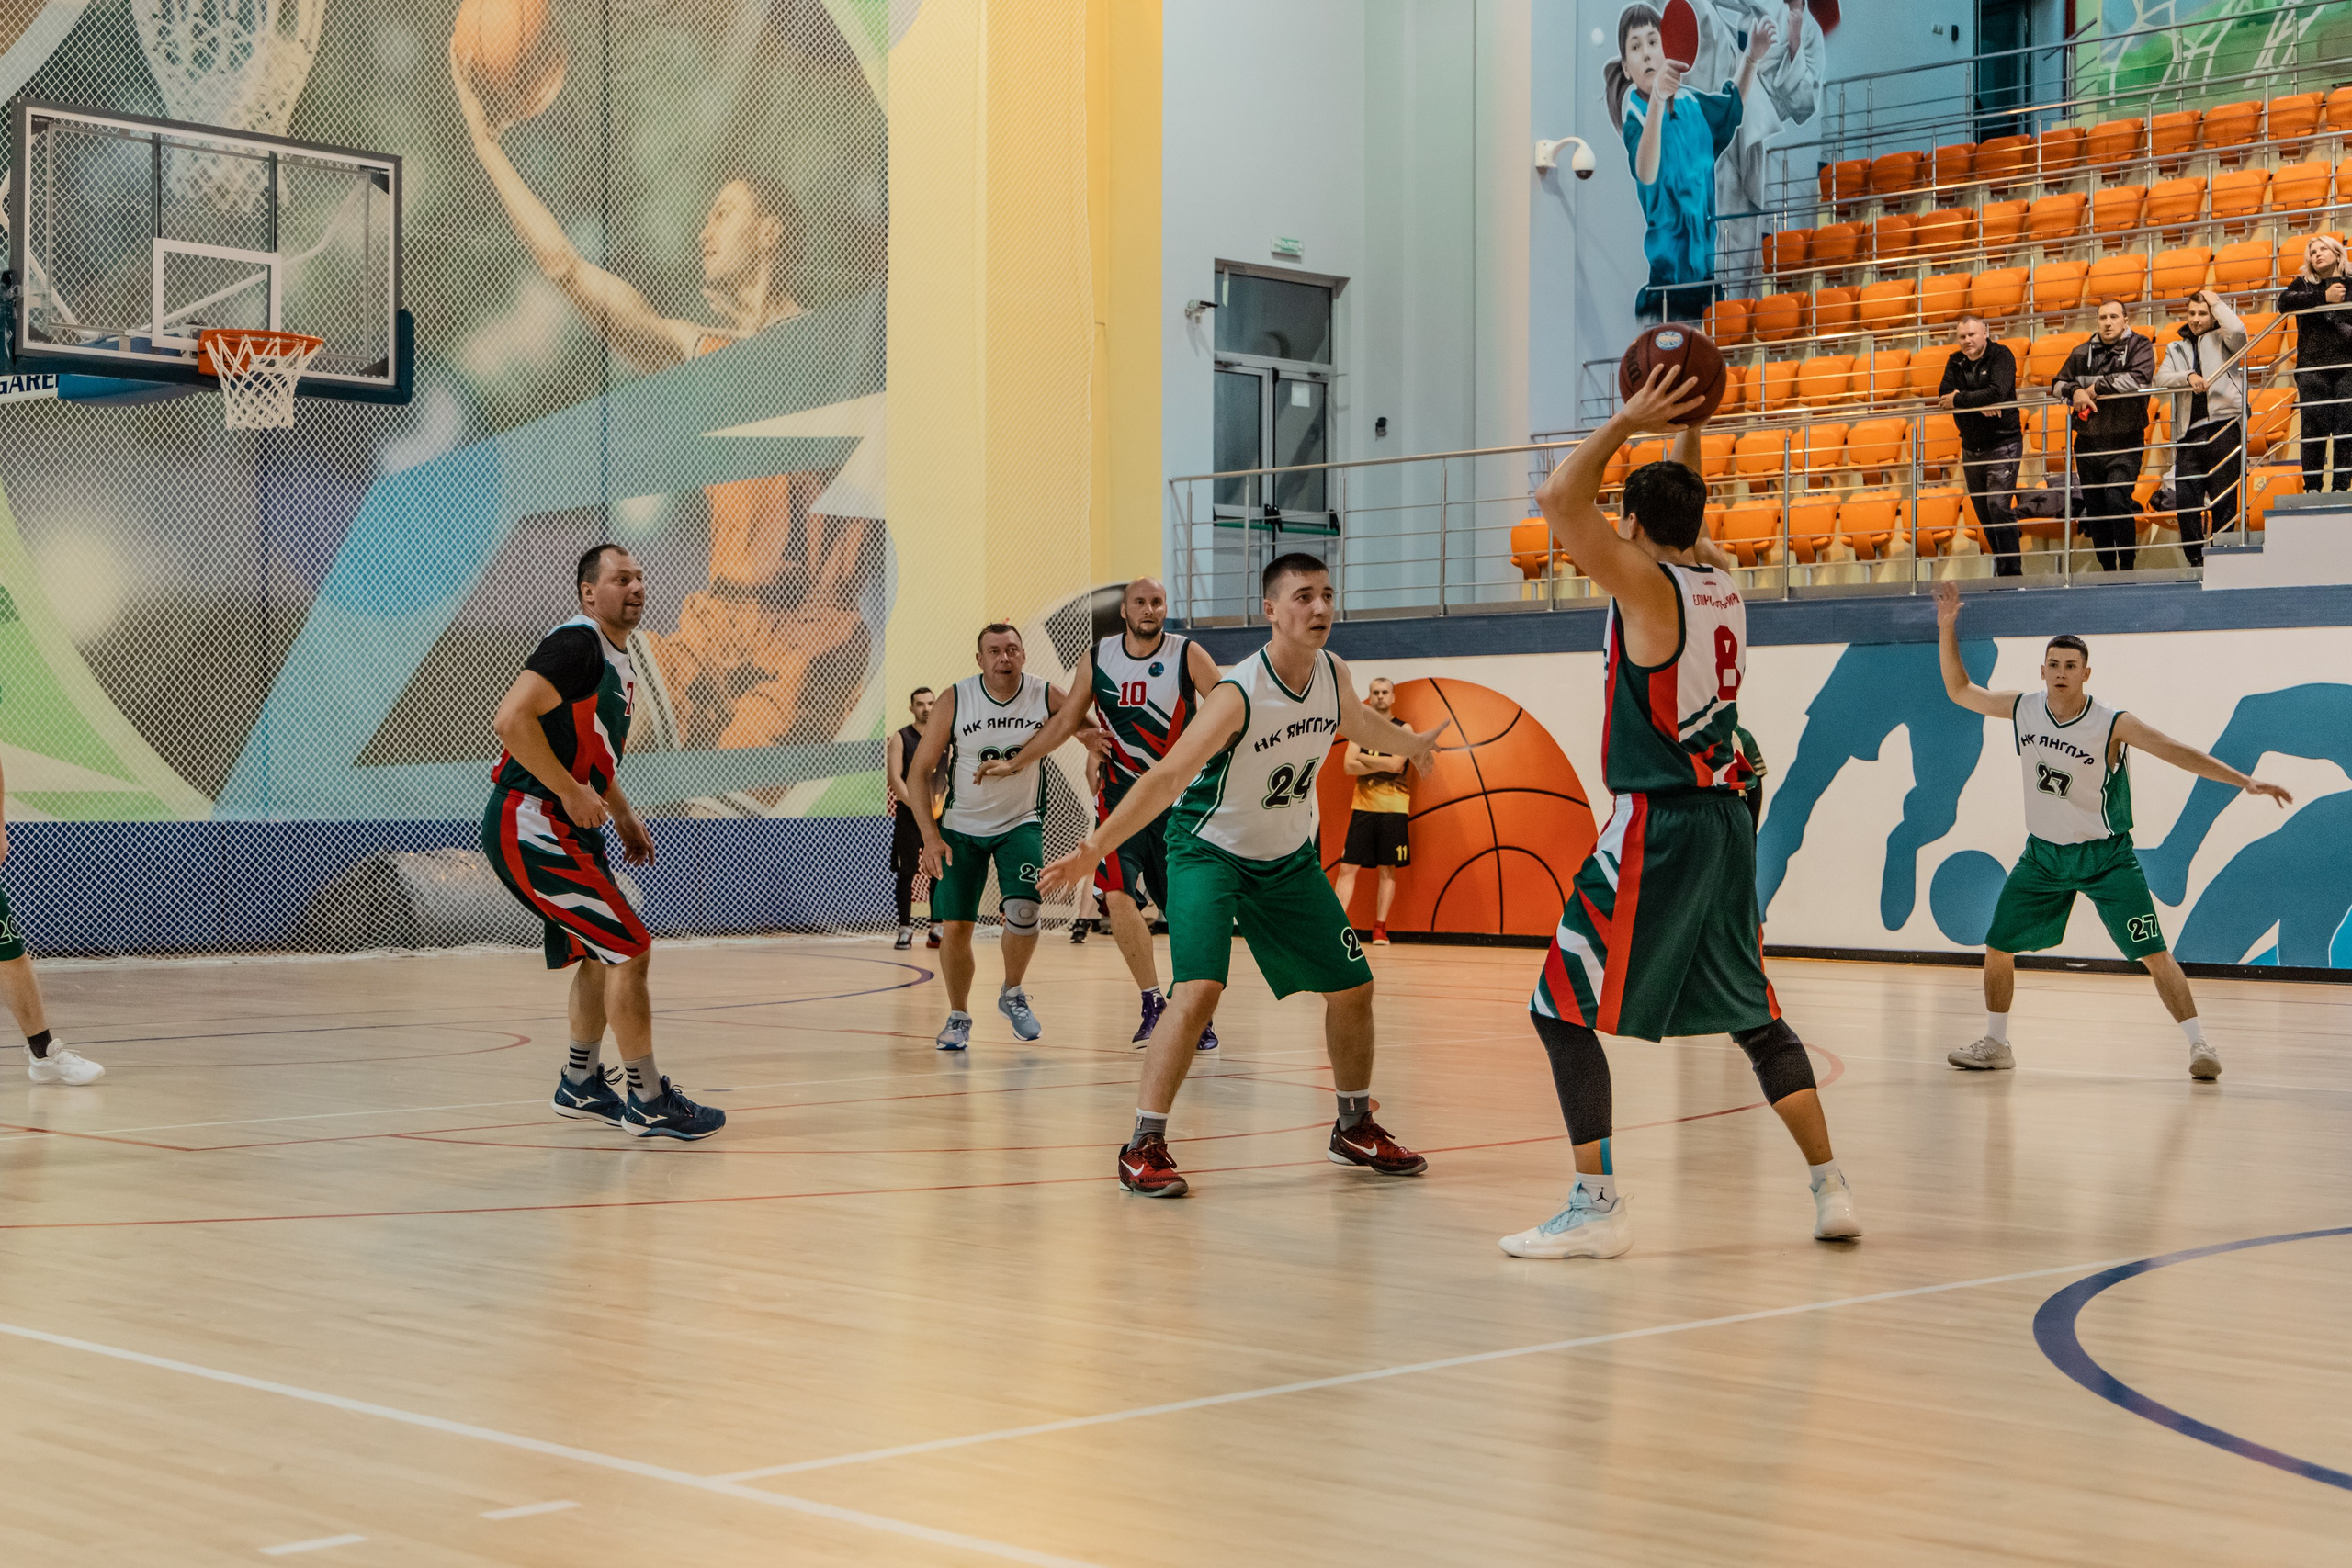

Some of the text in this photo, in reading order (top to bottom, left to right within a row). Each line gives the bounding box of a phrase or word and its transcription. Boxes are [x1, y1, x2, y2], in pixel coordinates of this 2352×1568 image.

[1714, 625, 1741, 701] 8
[1118, 681, 1147, 707] 10
[963, 717, 1043, 736] НК ЯНГПУР
[1254, 728, 1283, 752] НК
[2020, 734, 2095, 765] НК ЯНГПУР
[1261, 756, 1320, 810] 24
[2036, 761, 2073, 799] 27
[1396, 845, 1408, 862] 11
[2127, 914, 2158, 942] 27
